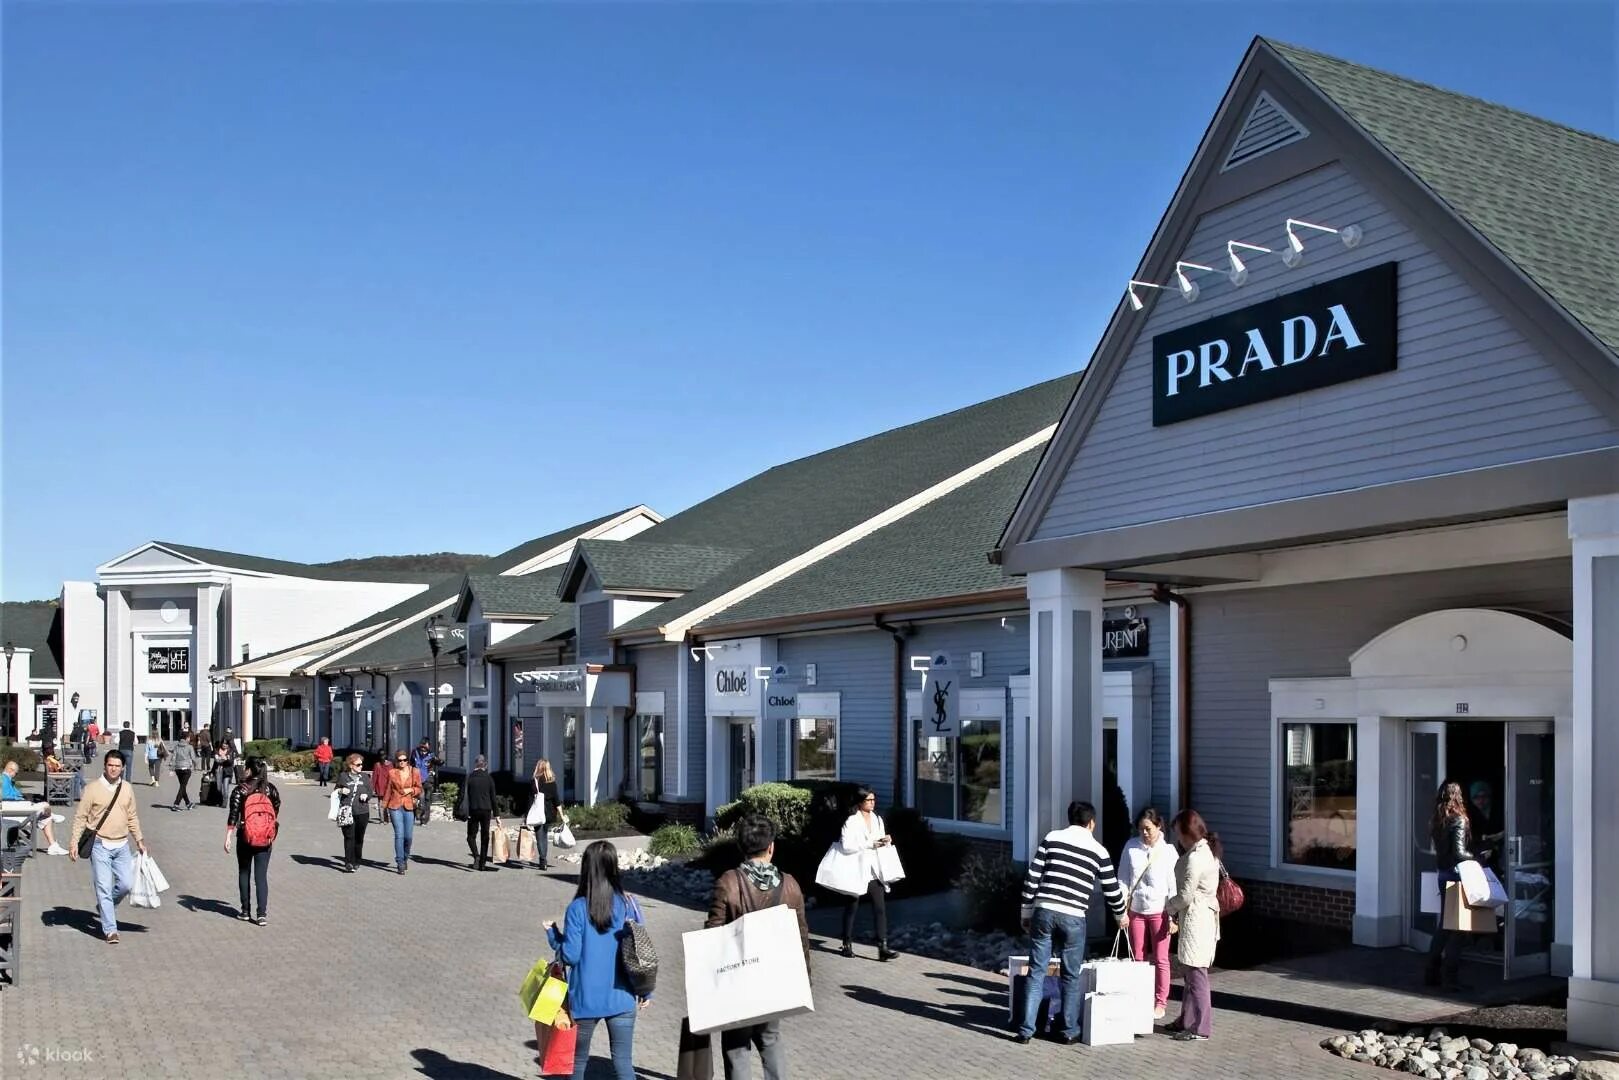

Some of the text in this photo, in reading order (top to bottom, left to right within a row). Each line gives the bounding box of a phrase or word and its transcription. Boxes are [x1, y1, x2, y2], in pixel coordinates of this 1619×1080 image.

[1165, 303, 1366, 397] PRADA
[170, 660, 187, 670] 5TH
[716, 670, 747, 692] Chloé
[768, 696, 795, 706] Chloé
